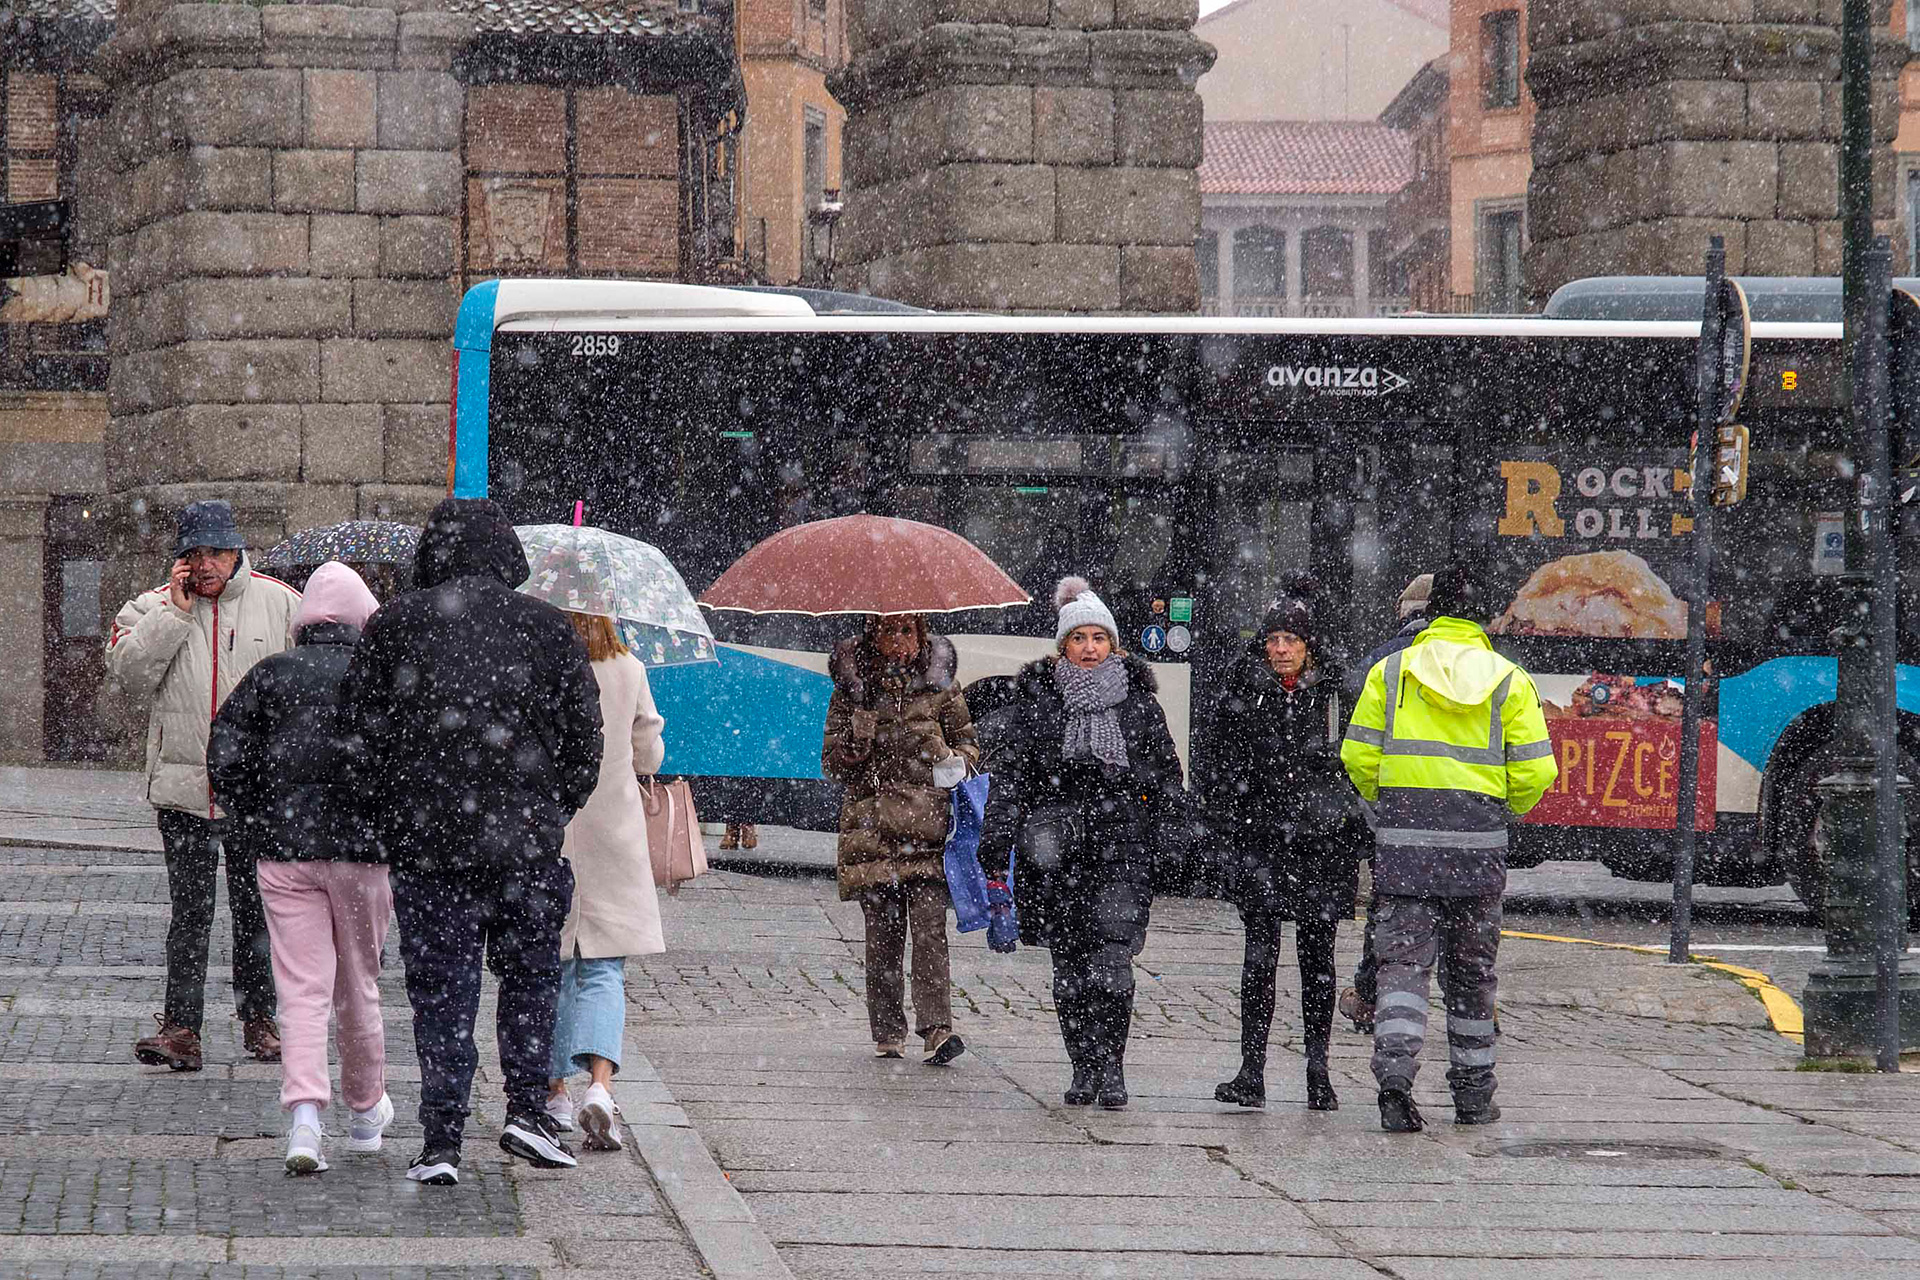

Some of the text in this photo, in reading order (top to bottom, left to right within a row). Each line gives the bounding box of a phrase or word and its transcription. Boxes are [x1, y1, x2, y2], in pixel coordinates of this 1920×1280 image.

[571, 335, 619, 356] 2859
[1267, 365, 1378, 387] avanza
[1549, 731, 1673, 807] PIZCE
